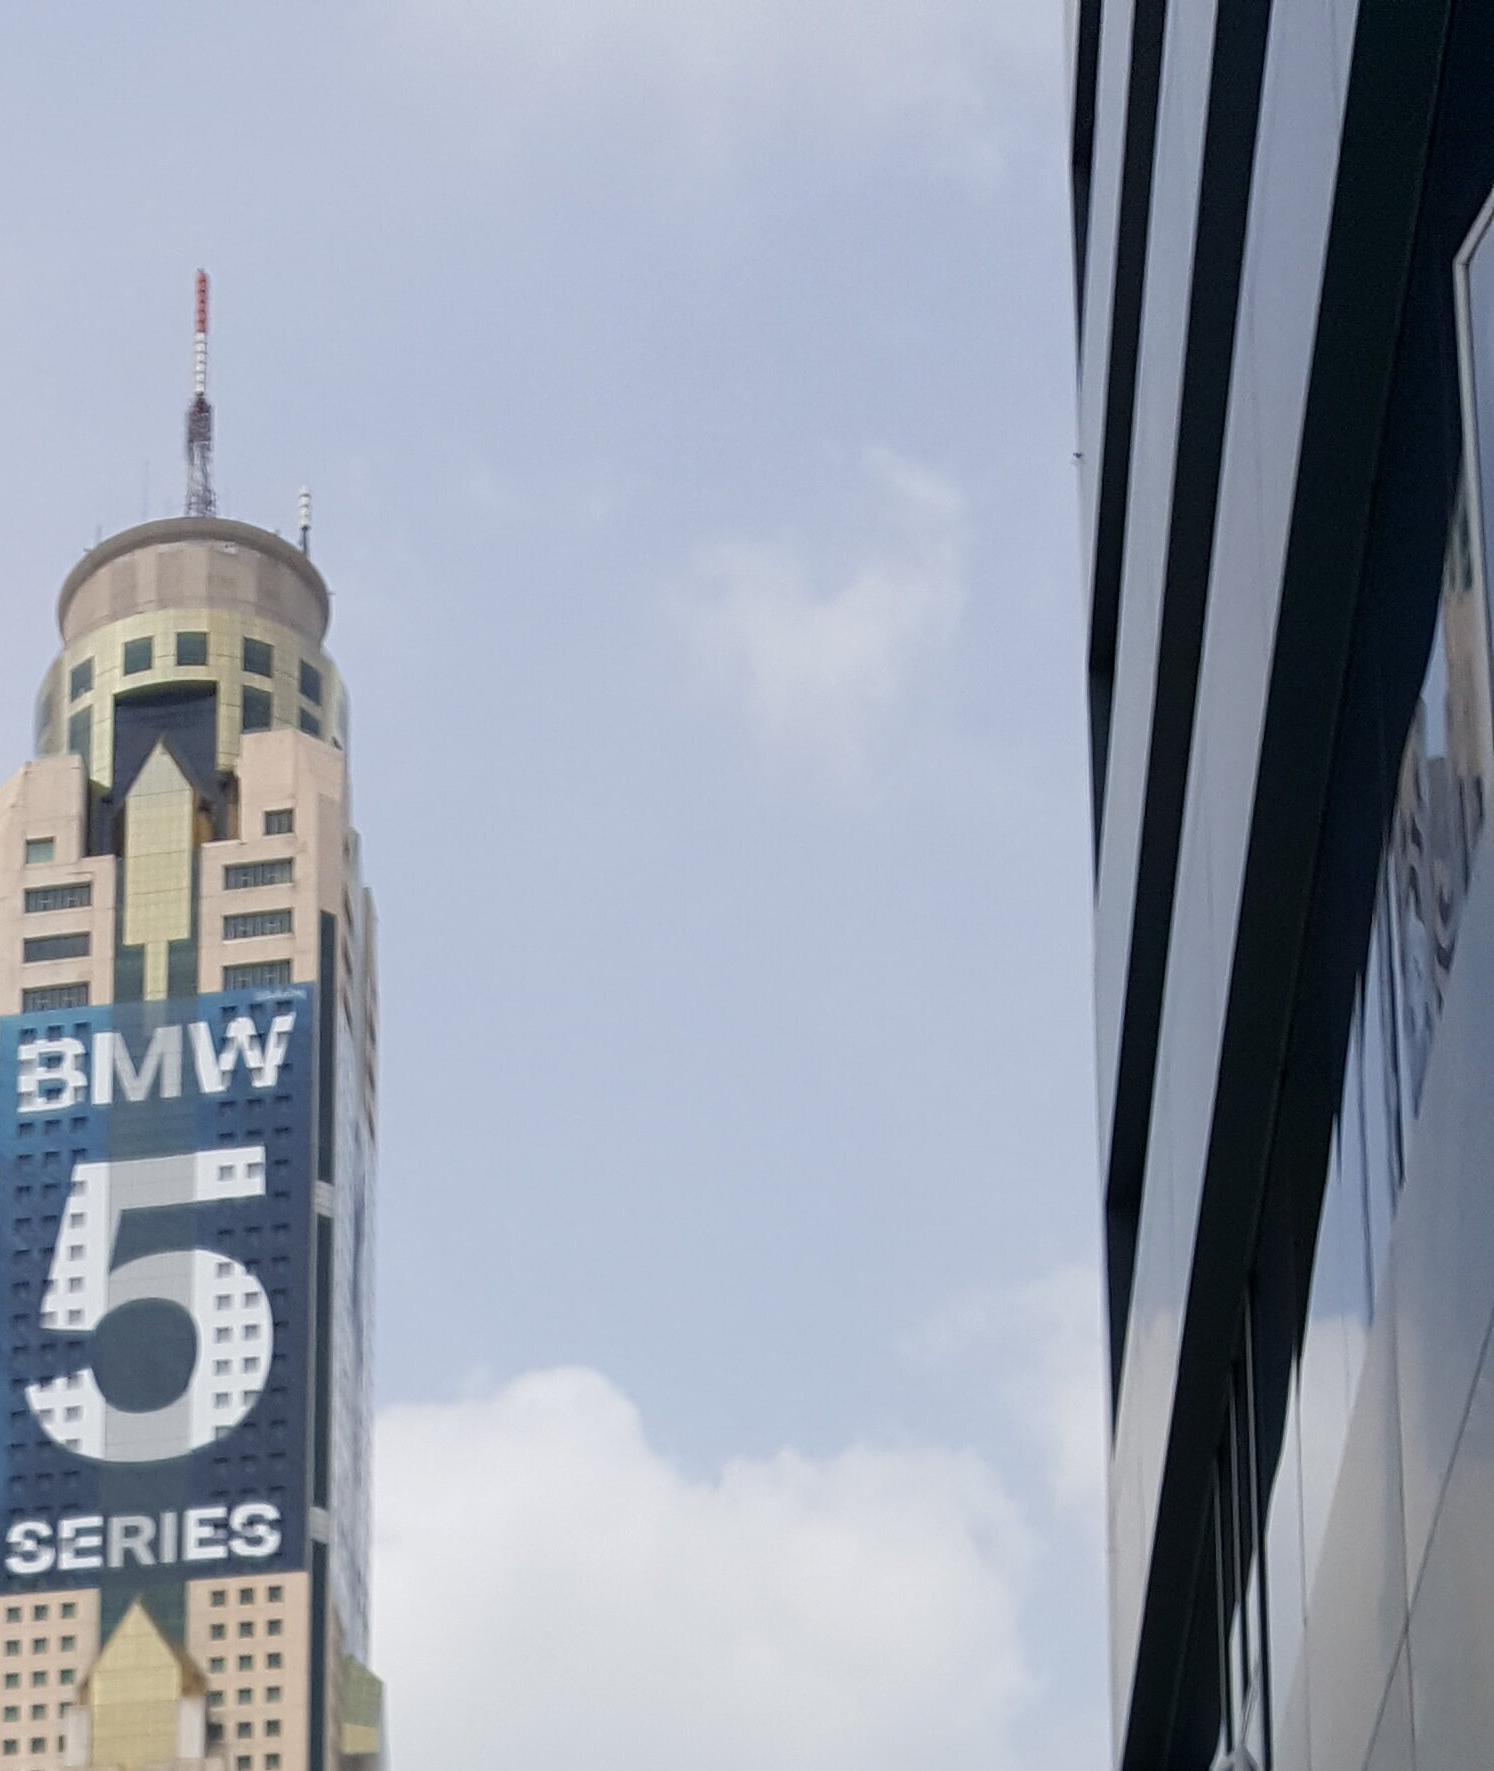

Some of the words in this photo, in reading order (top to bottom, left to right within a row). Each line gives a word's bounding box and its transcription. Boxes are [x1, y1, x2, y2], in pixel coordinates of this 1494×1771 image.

[17, 1011, 296, 1113] BMW
[24, 1145, 274, 1463] 5
[6, 1502, 282, 1575] SERIES
